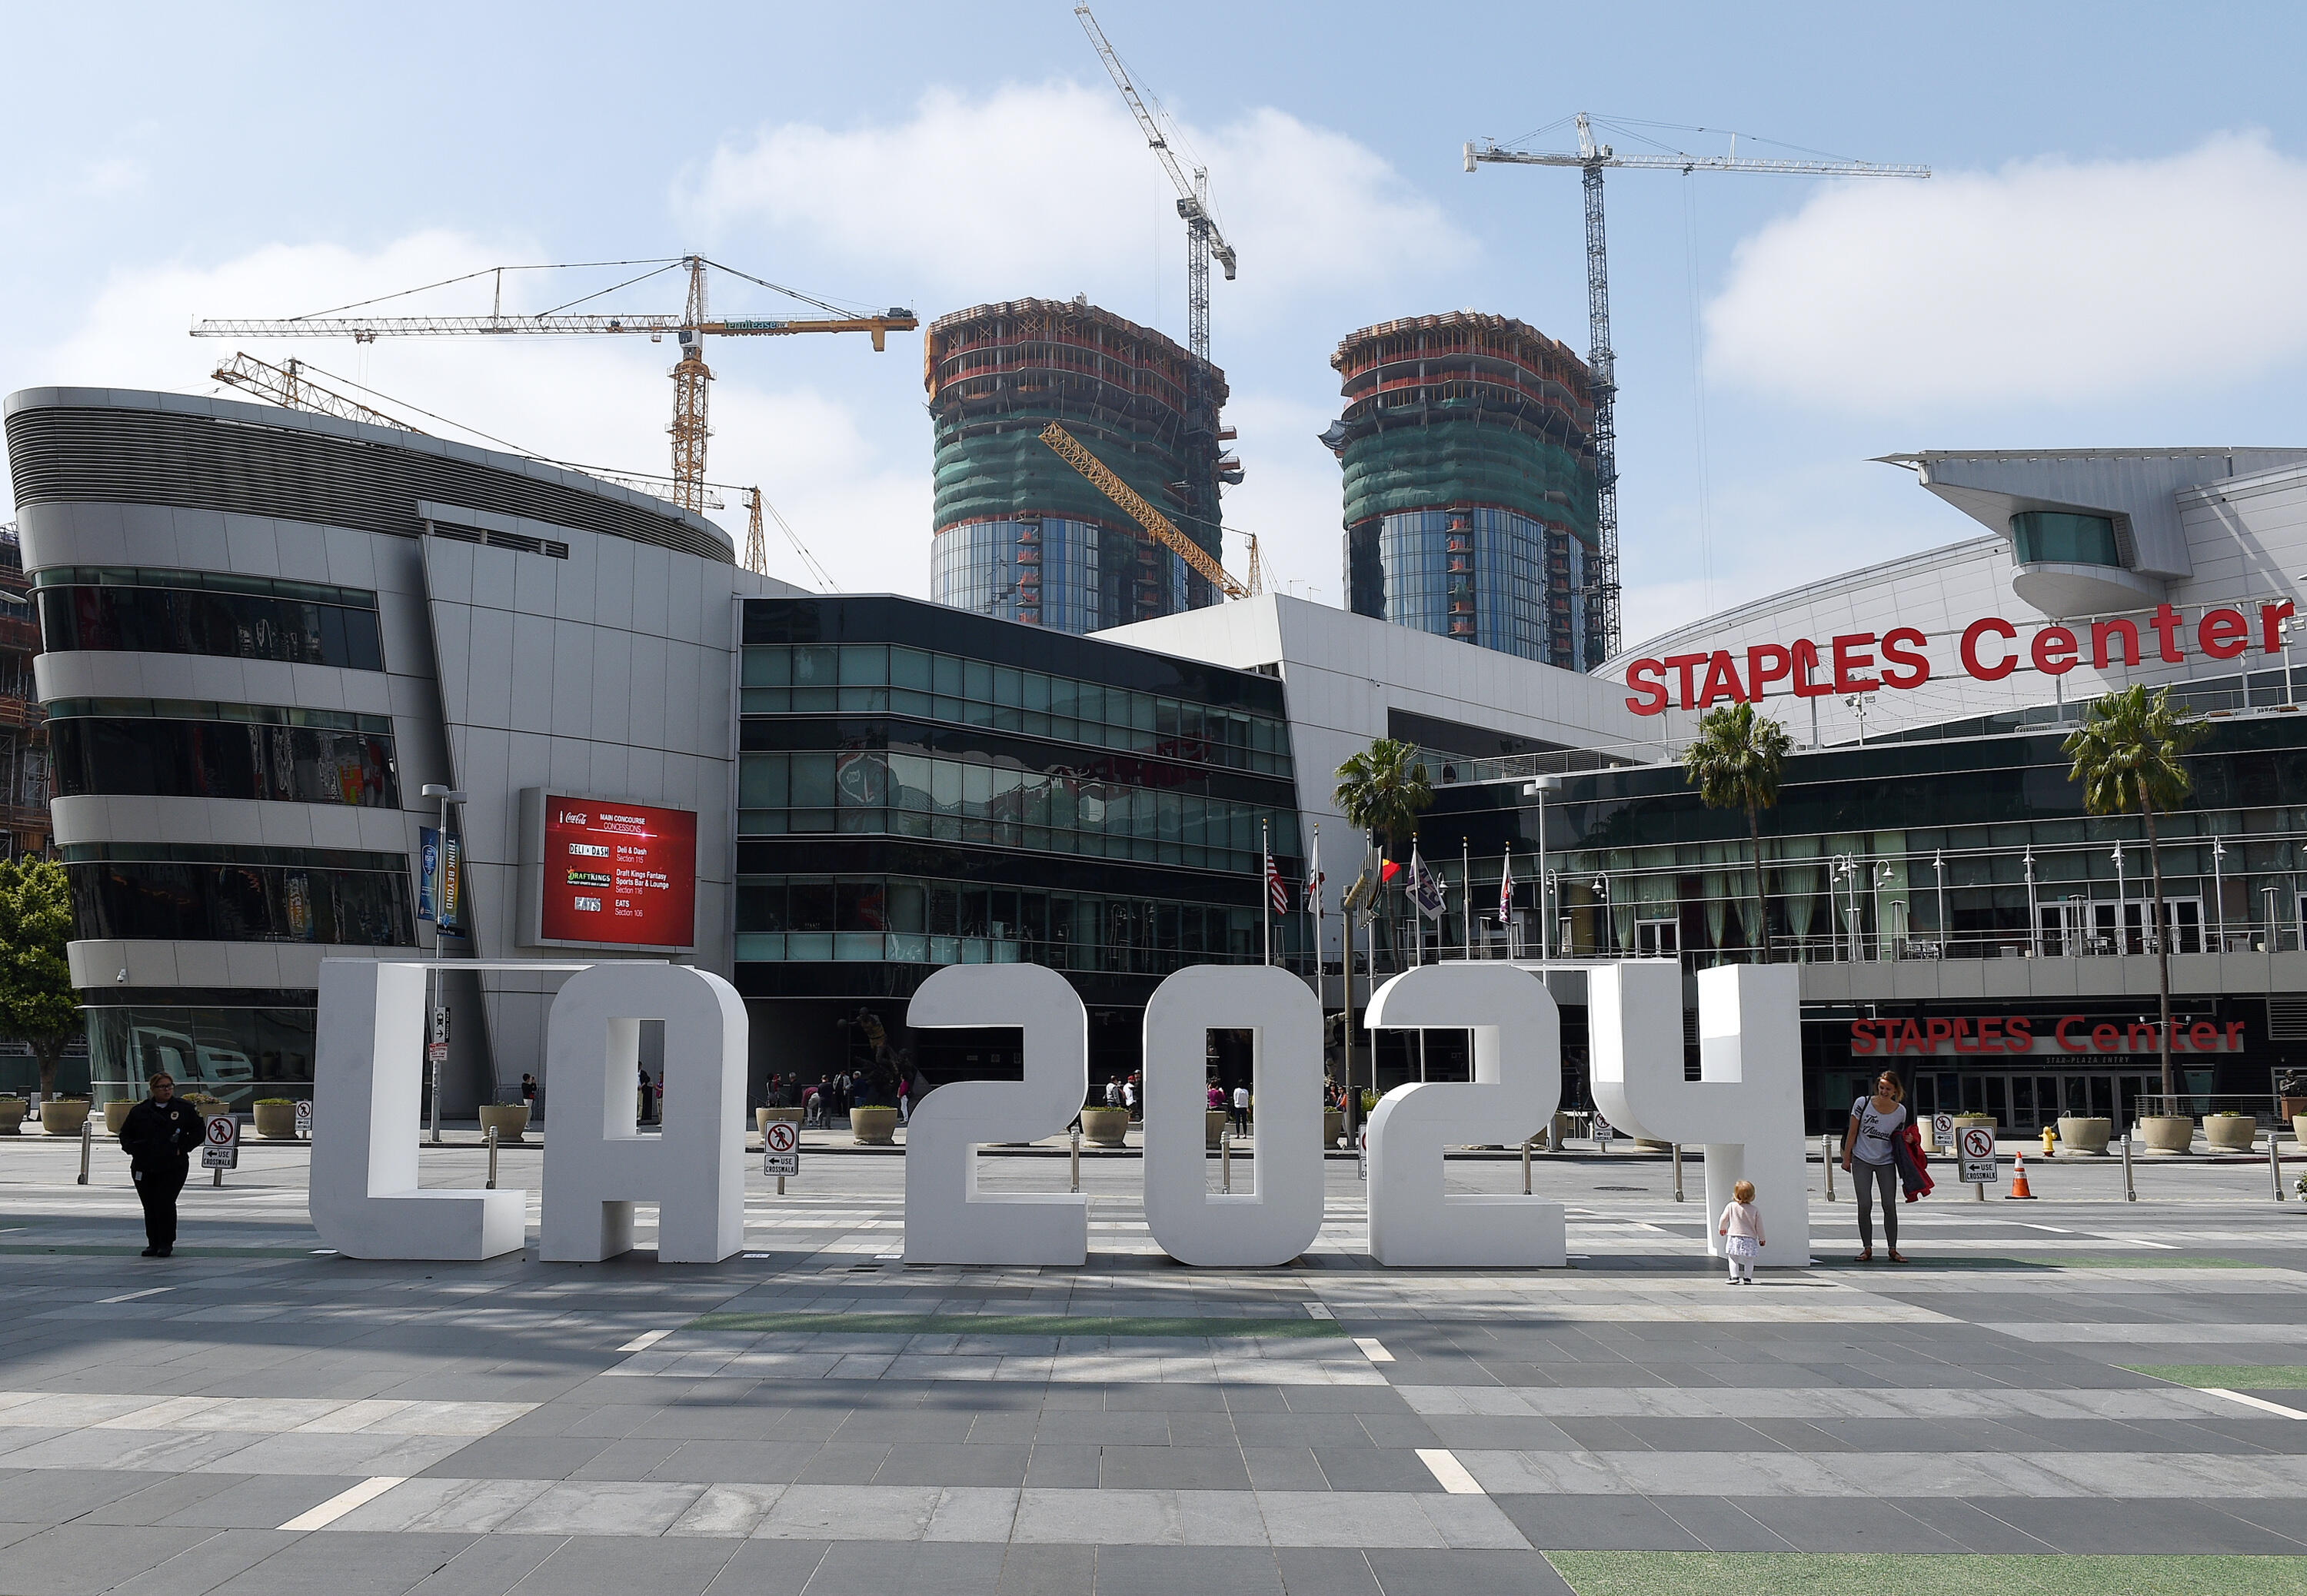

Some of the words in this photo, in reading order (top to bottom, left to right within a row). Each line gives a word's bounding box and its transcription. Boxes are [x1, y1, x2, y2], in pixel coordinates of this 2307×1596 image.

[724, 319, 776, 330] lendlease
[1625, 627, 1929, 716] STAPLES
[1960, 598, 2294, 681] Center
[614, 816, 645, 824] CONCOURSE
[604, 823, 641, 833] CONCESSIONS
[571, 845, 584, 853] DELI
[592, 847, 609, 856] DASH
[568, 873, 611, 882] DRAFTKINGS
[631, 870, 645, 879] Kings
[647, 872, 666, 881] Fantasy
[616, 877, 633, 886] Sports
[651, 880, 669, 889] Lounge
[446, 870, 455, 909] BEYOND
[575, 897, 600, 910] EATS
[1851, 1018, 2032, 1053] STAPLES
[2056, 1015, 2244, 1052] Center
[309, 959, 748, 1263] LA
[904, 964, 1809, 1266] 2024
[1864, 1114, 1879, 1124] The
